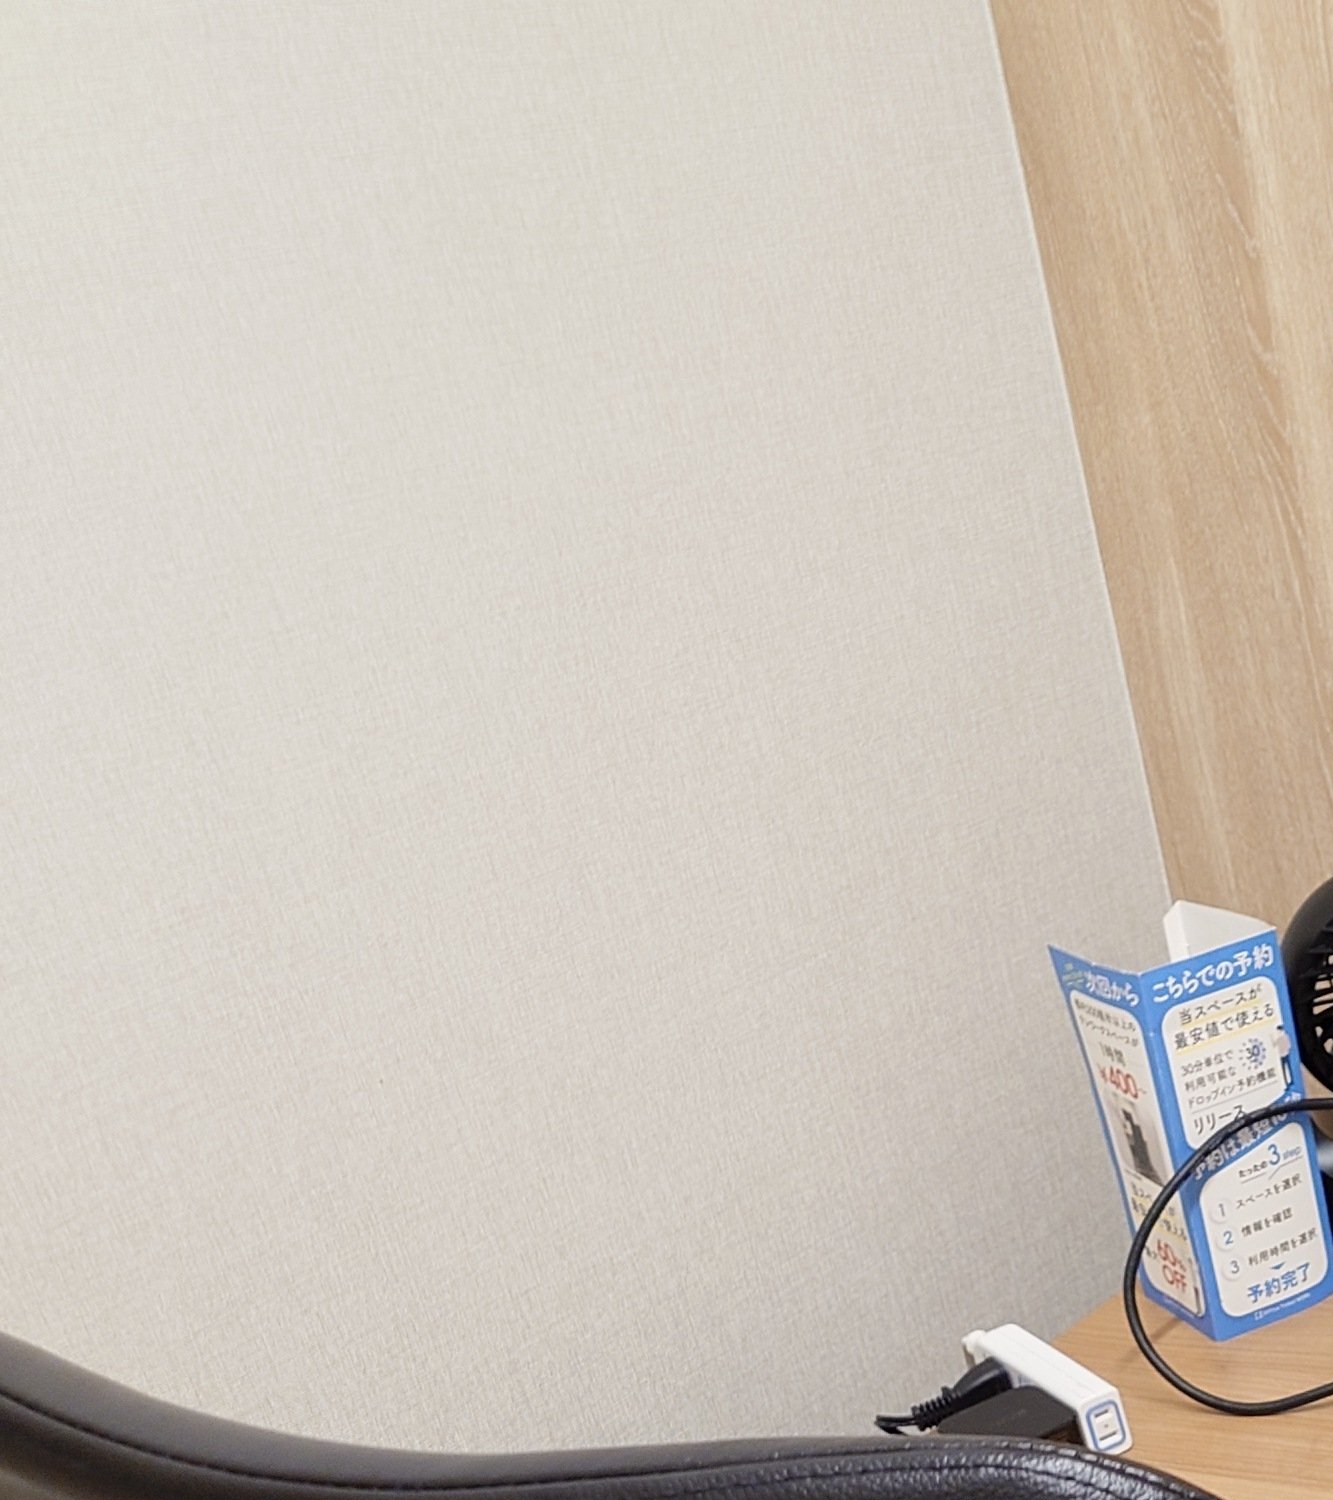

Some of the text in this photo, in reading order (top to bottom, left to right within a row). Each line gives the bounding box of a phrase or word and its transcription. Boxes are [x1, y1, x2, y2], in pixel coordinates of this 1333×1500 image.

[1152, 943, 1274, 1003] こちらでの予約
[1178, 982, 1264, 1026] 当スペースが
[1173, 1003, 1275, 1050] 最安値で使える
[1184, 1065, 1237, 1092] 利用可能な
[1187, 1067, 1277, 1109] ドロップイン予約機能
[1235, 1173, 1302, 1209] スペースを選択
[1223, 1207, 1294, 1246] 2 情報を確認
[1229, 1227, 1318, 1275] 3 利用時間を選択
[1247, 1262, 1311, 1304] 予約完了
